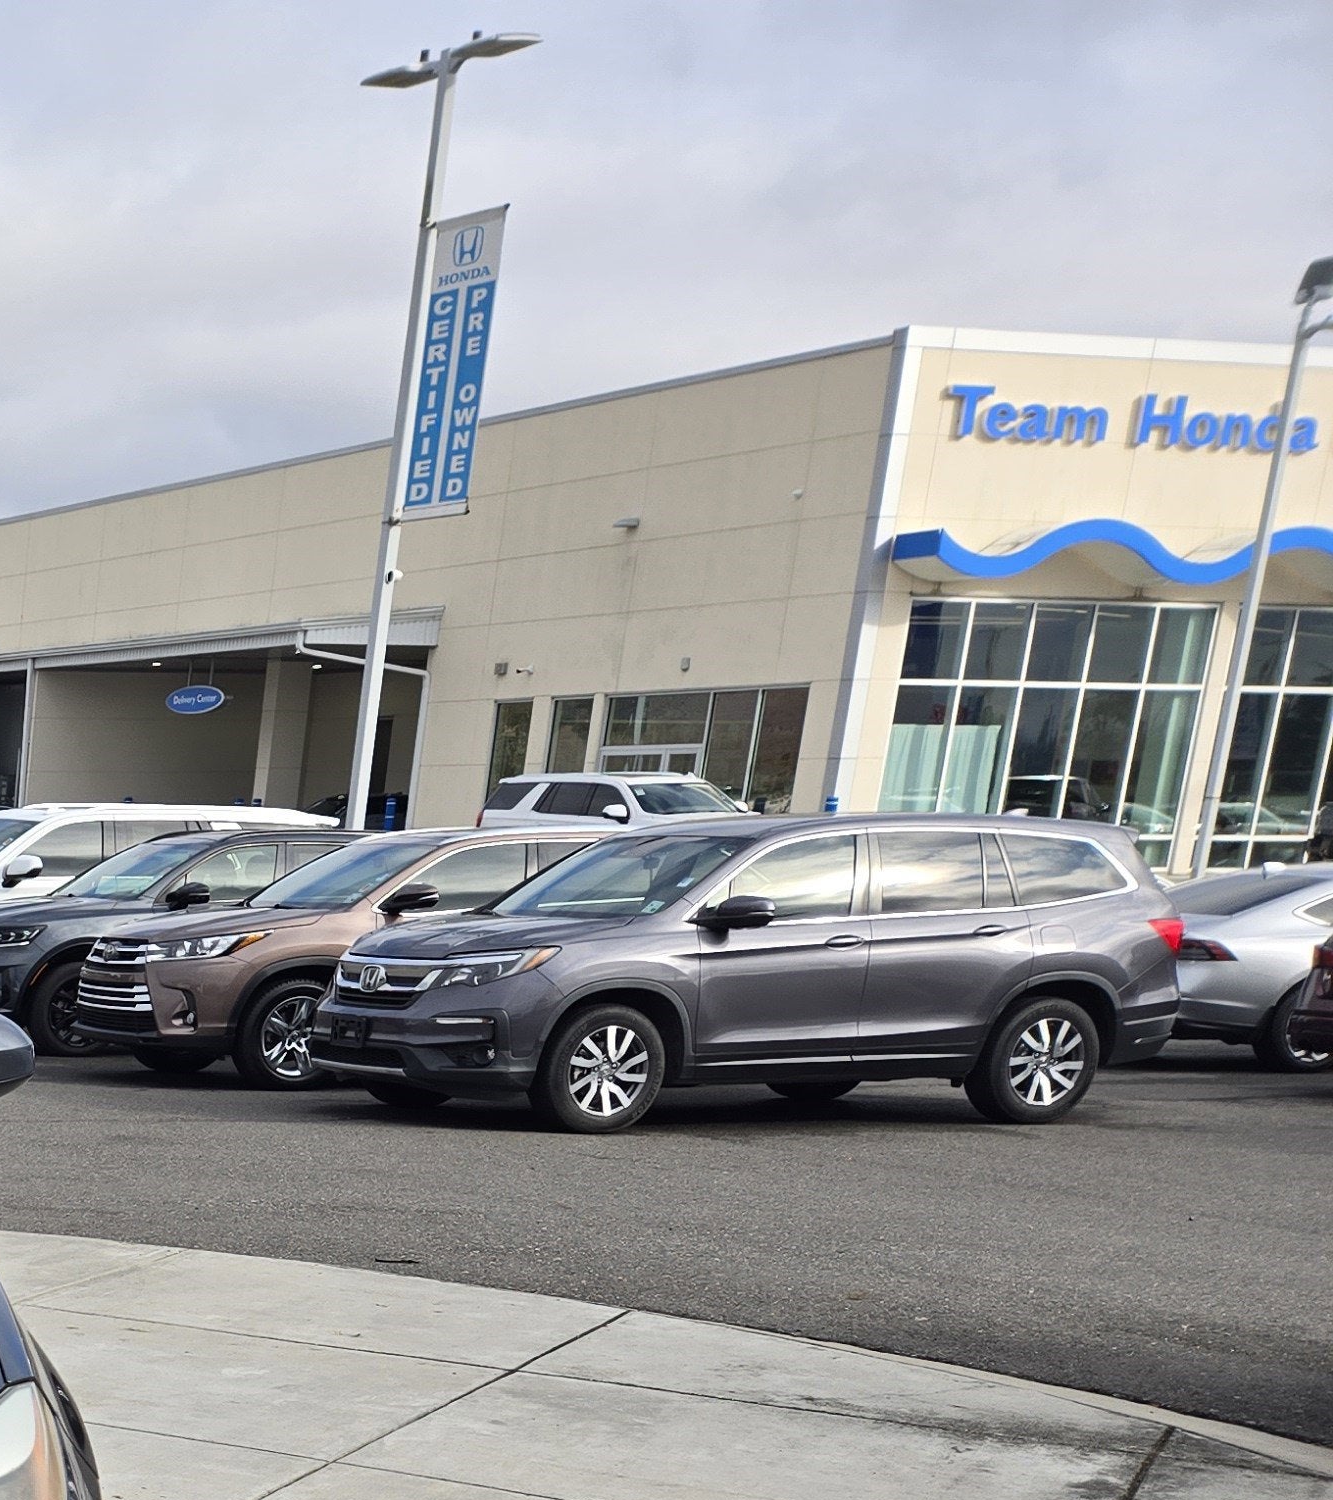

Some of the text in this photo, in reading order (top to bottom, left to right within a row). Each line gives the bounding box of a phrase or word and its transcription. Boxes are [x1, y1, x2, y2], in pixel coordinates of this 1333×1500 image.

[438, 266, 491, 287] HONDA
[409, 295, 454, 502] CERTIFIED
[446, 287, 489, 497] PRE OWNED
[946, 384, 1110, 442] Team
